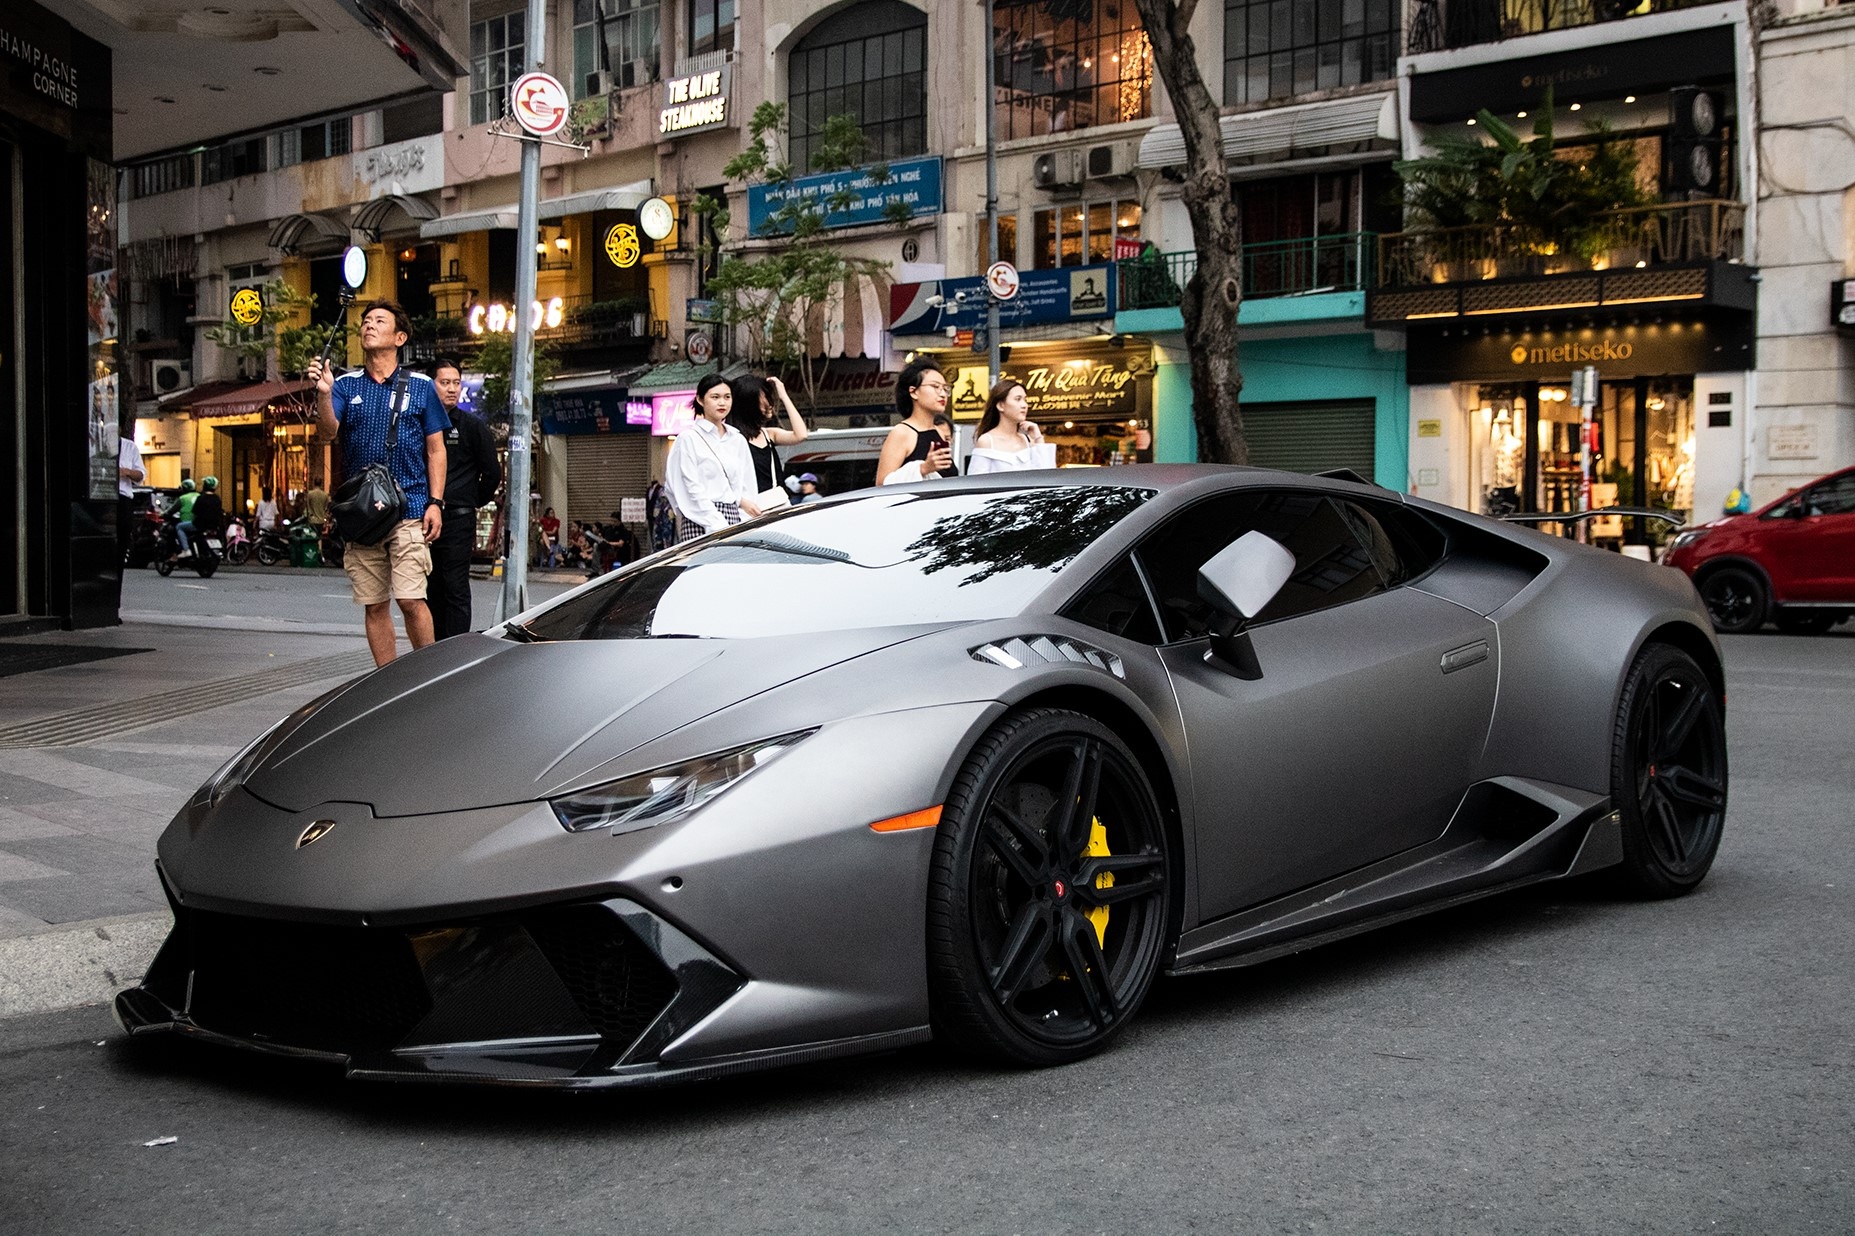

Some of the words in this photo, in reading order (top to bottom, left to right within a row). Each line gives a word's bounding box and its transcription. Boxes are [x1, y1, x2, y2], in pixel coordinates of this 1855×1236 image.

[0, 28, 78, 88] HAMPAGNE
[33, 72, 78, 109] CORNER
[669, 77, 690, 105] THE
[689, 70, 722, 100] OLIVE
[659, 96, 727, 133] STEAKHOUSE
[849, 199, 865, 211] KHU
[867, 192, 884, 209] PHỐ
[903, 189, 919, 203] HÓA
[1530, 339, 1613, 364] metiseko
[1025, 367, 1055, 393] Thị
[1090, 364, 1132, 389] Tặng
[1042, 393, 1092, 403] Souvenir
[1093, 390, 1126, 400] Mart
